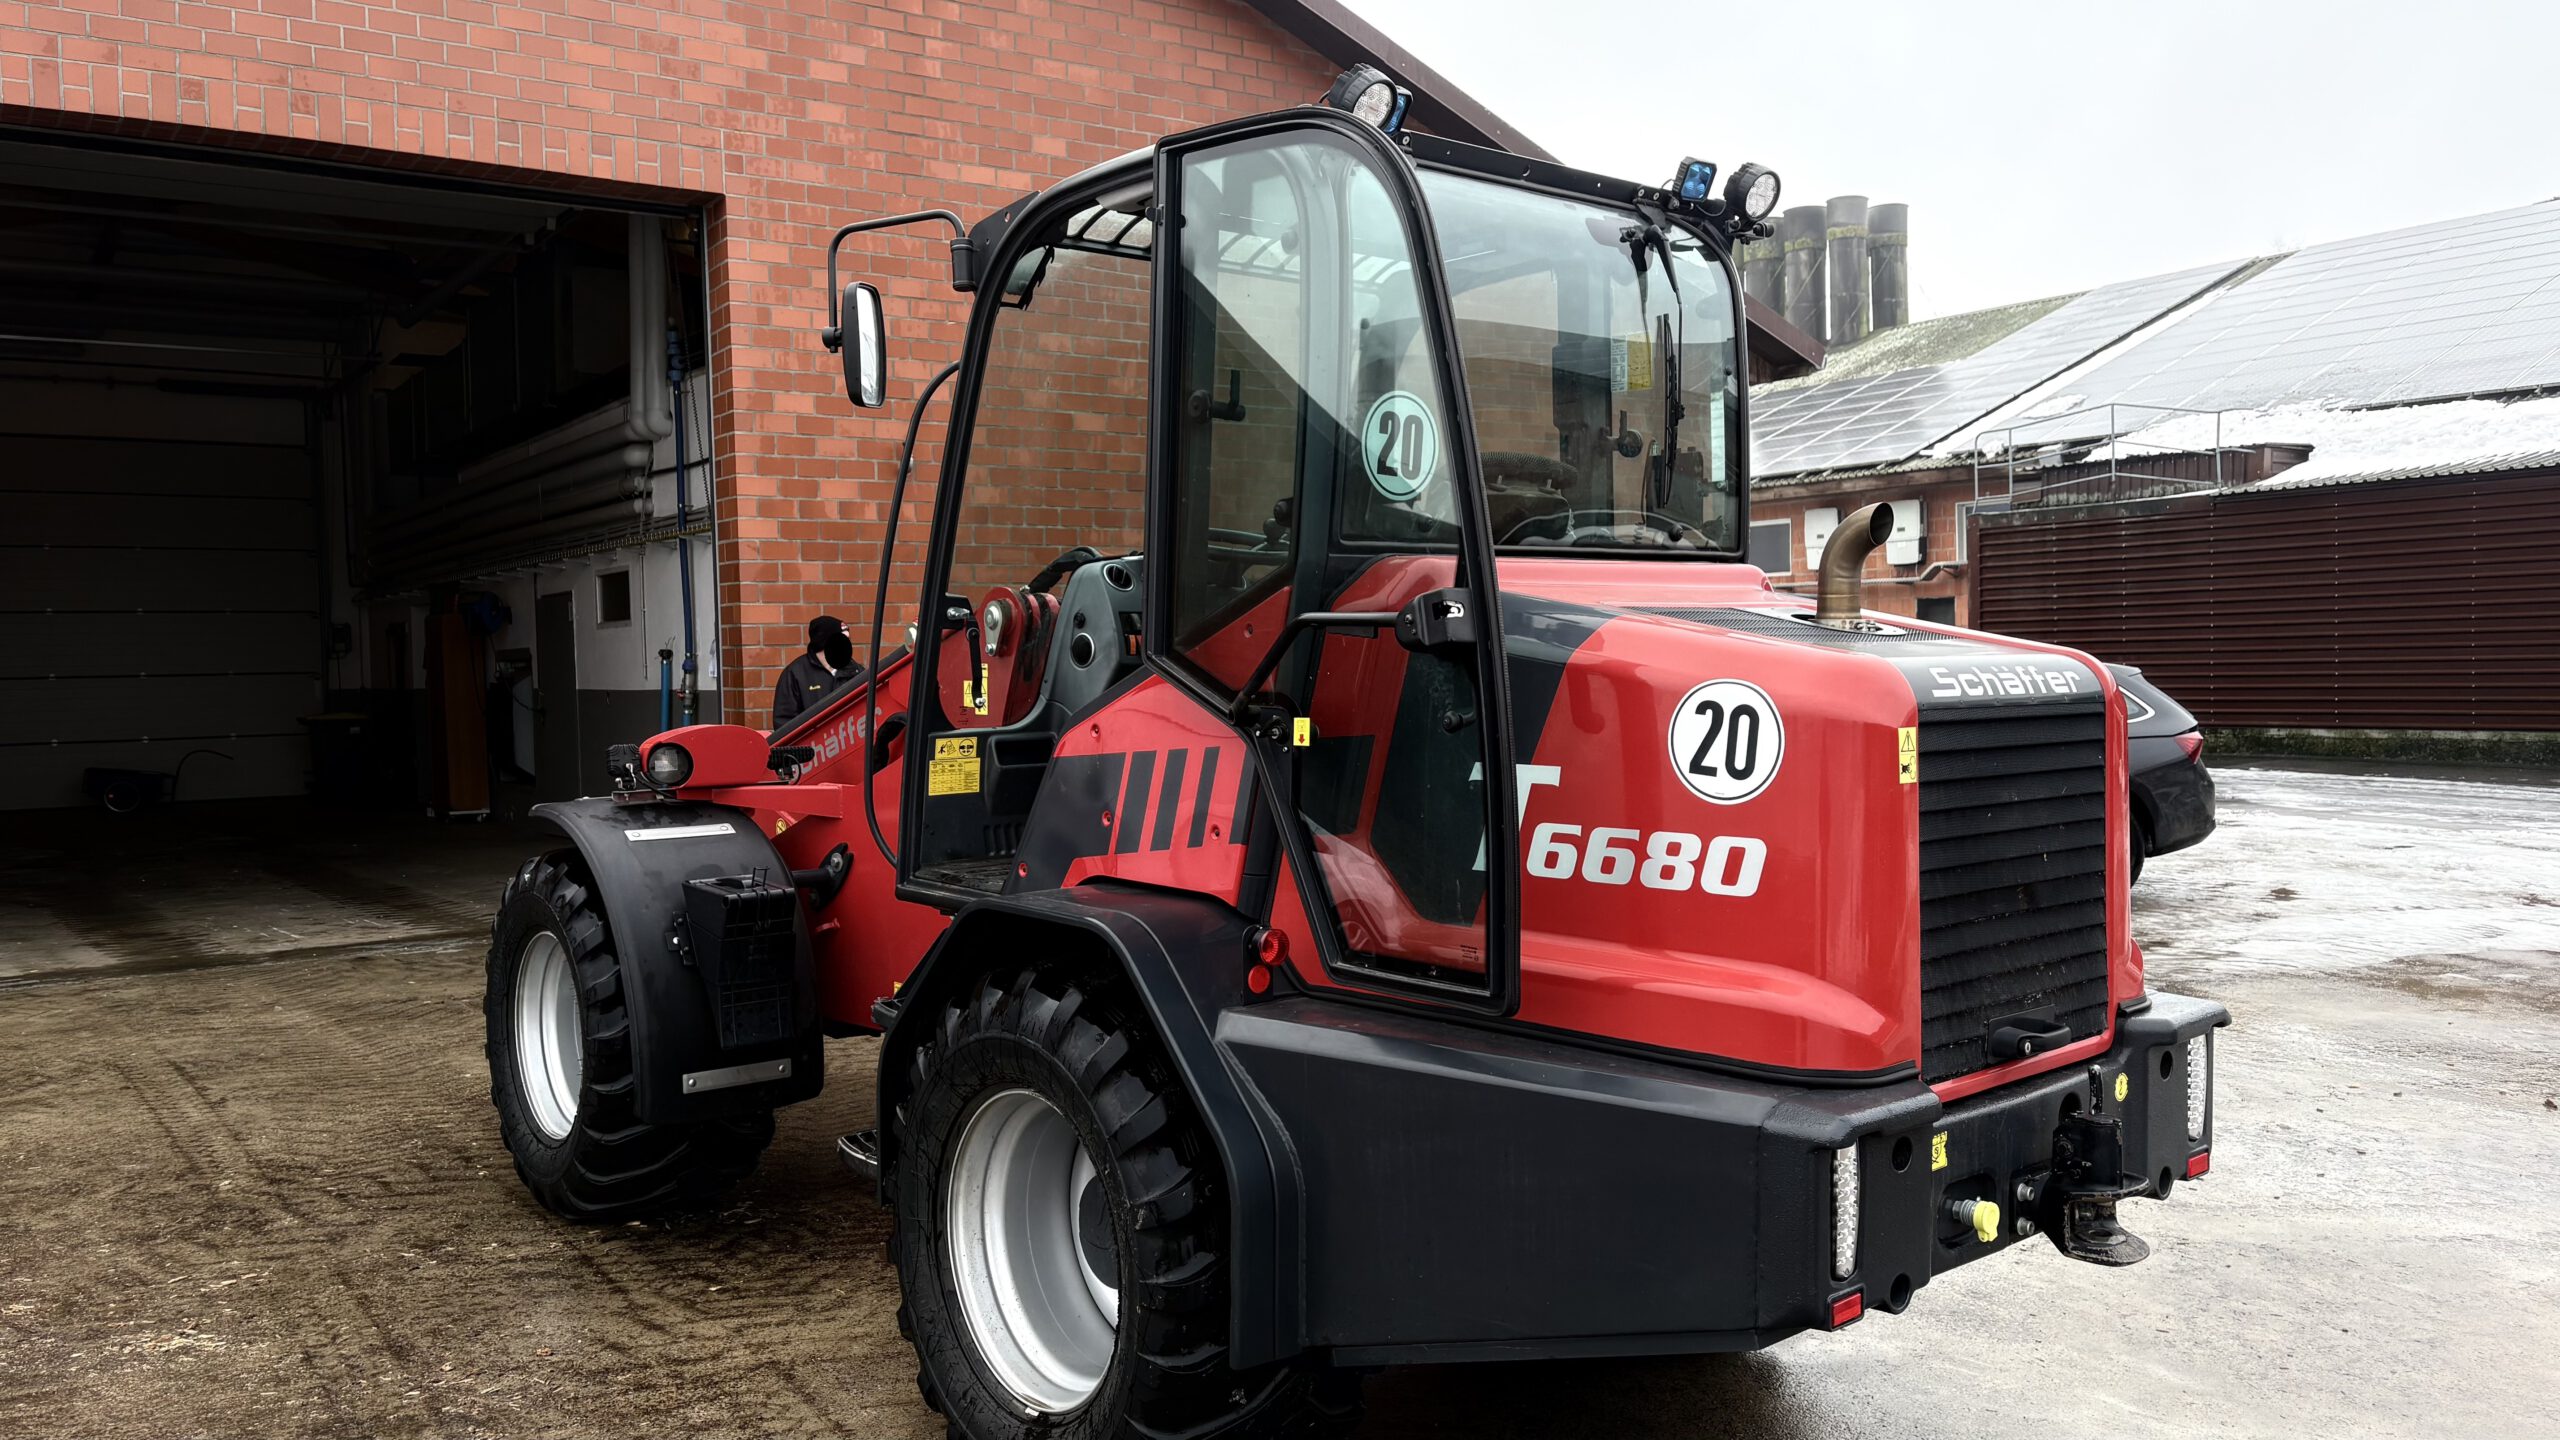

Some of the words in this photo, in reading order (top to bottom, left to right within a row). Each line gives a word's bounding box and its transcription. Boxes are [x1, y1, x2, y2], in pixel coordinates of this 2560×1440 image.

[1377, 411, 1423, 480] 20
[1929, 665, 2080, 697] Schäffer
[1689, 700, 1760, 780] 20
